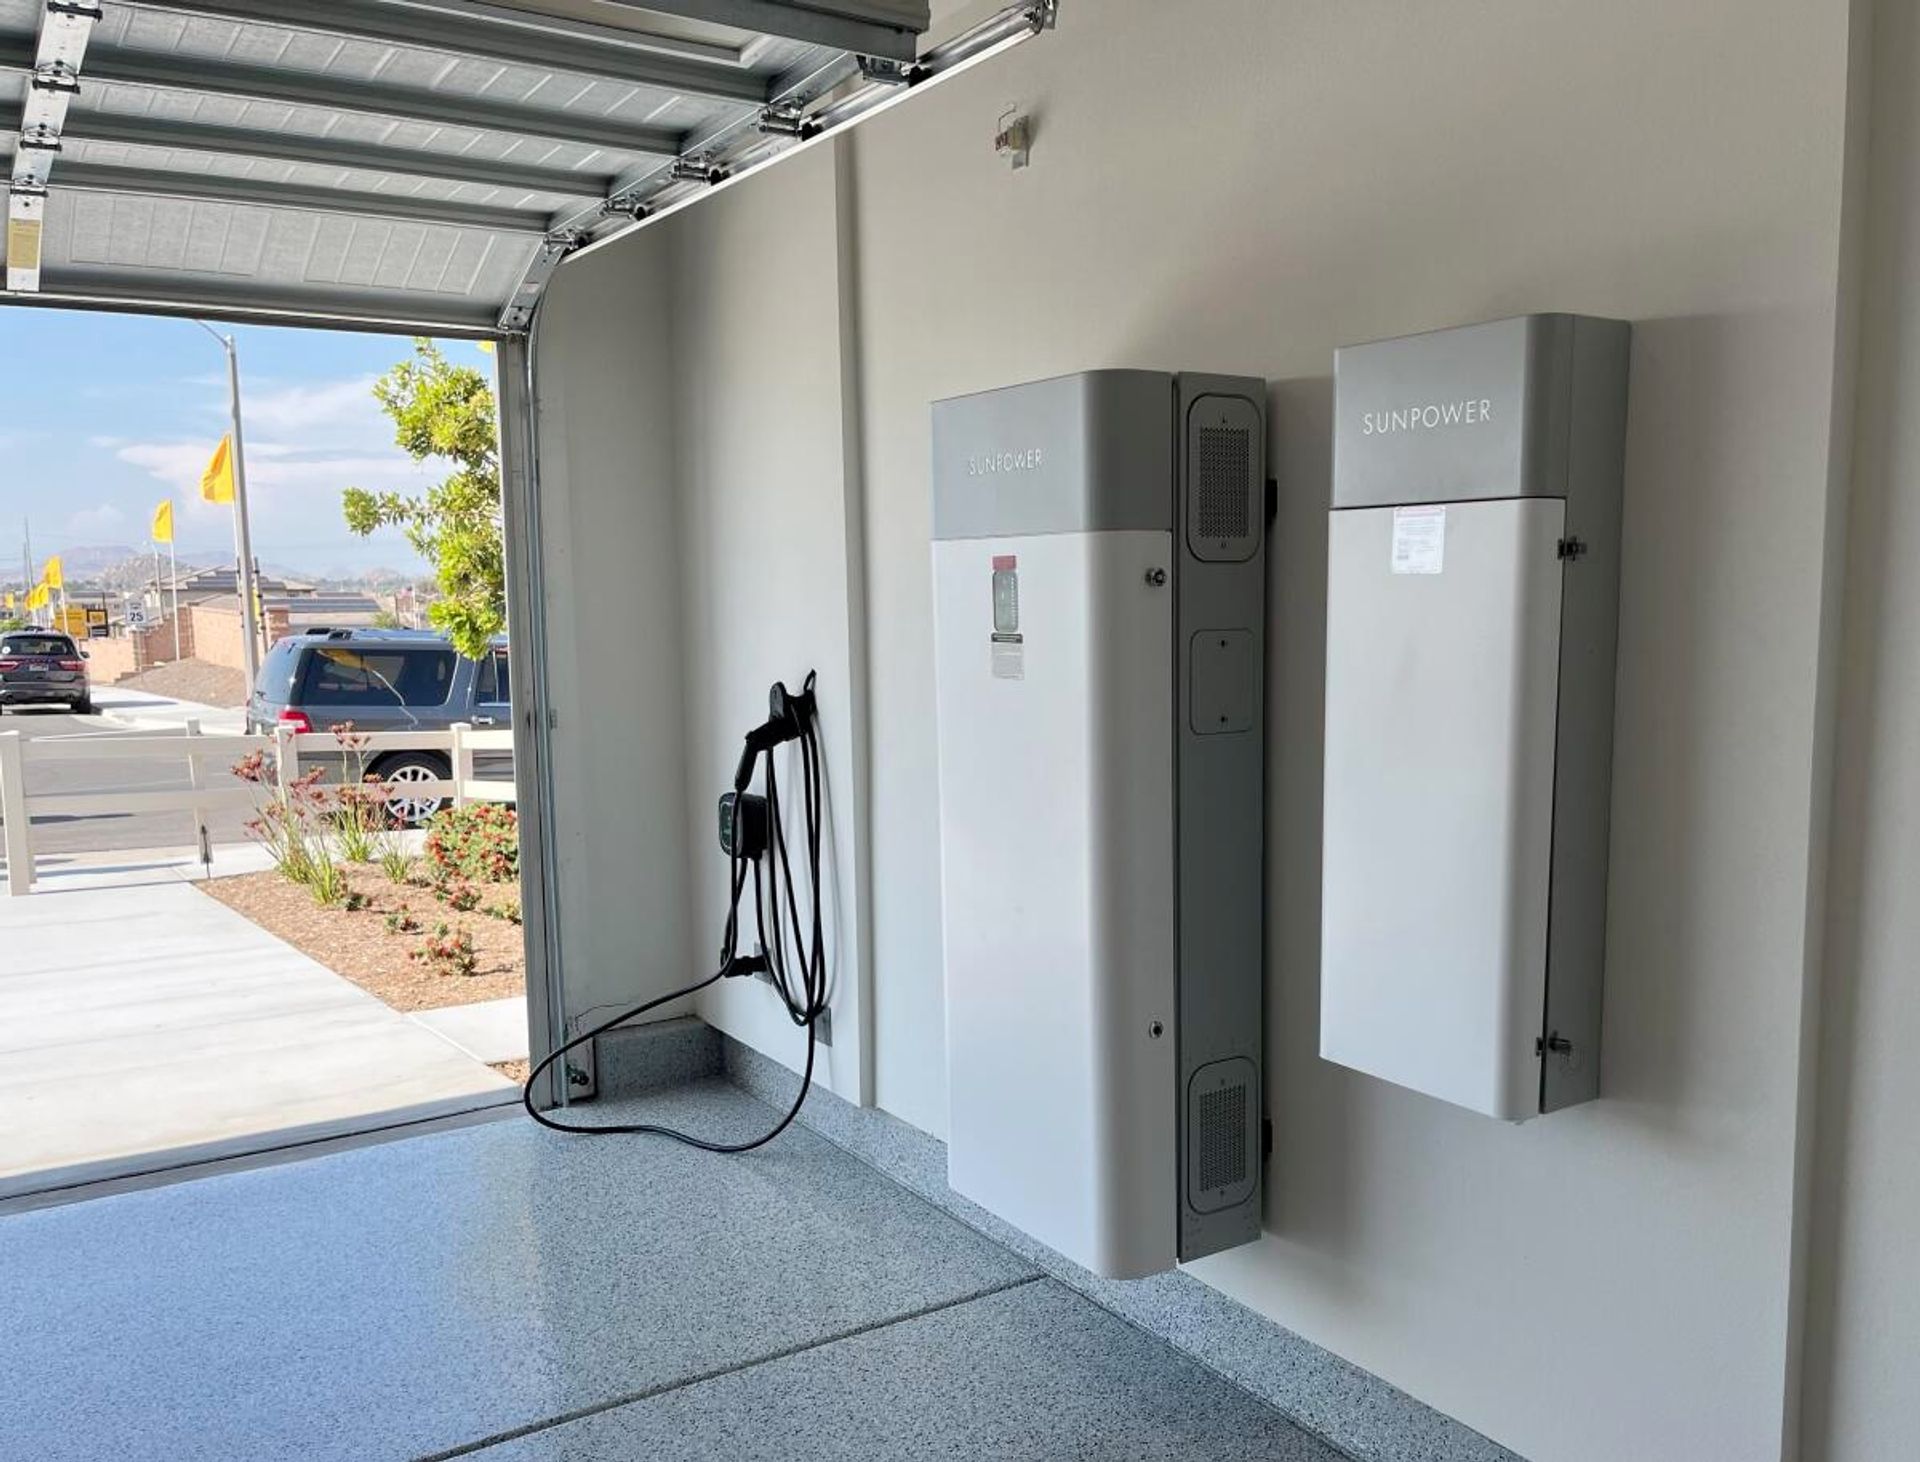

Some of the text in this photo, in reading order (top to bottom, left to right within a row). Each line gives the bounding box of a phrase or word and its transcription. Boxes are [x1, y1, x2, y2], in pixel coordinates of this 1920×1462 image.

[1363, 399, 1491, 435] SUNPOWER
[968, 448, 1042, 475] SUNPOWER
[129, 611, 144, 622] 25
